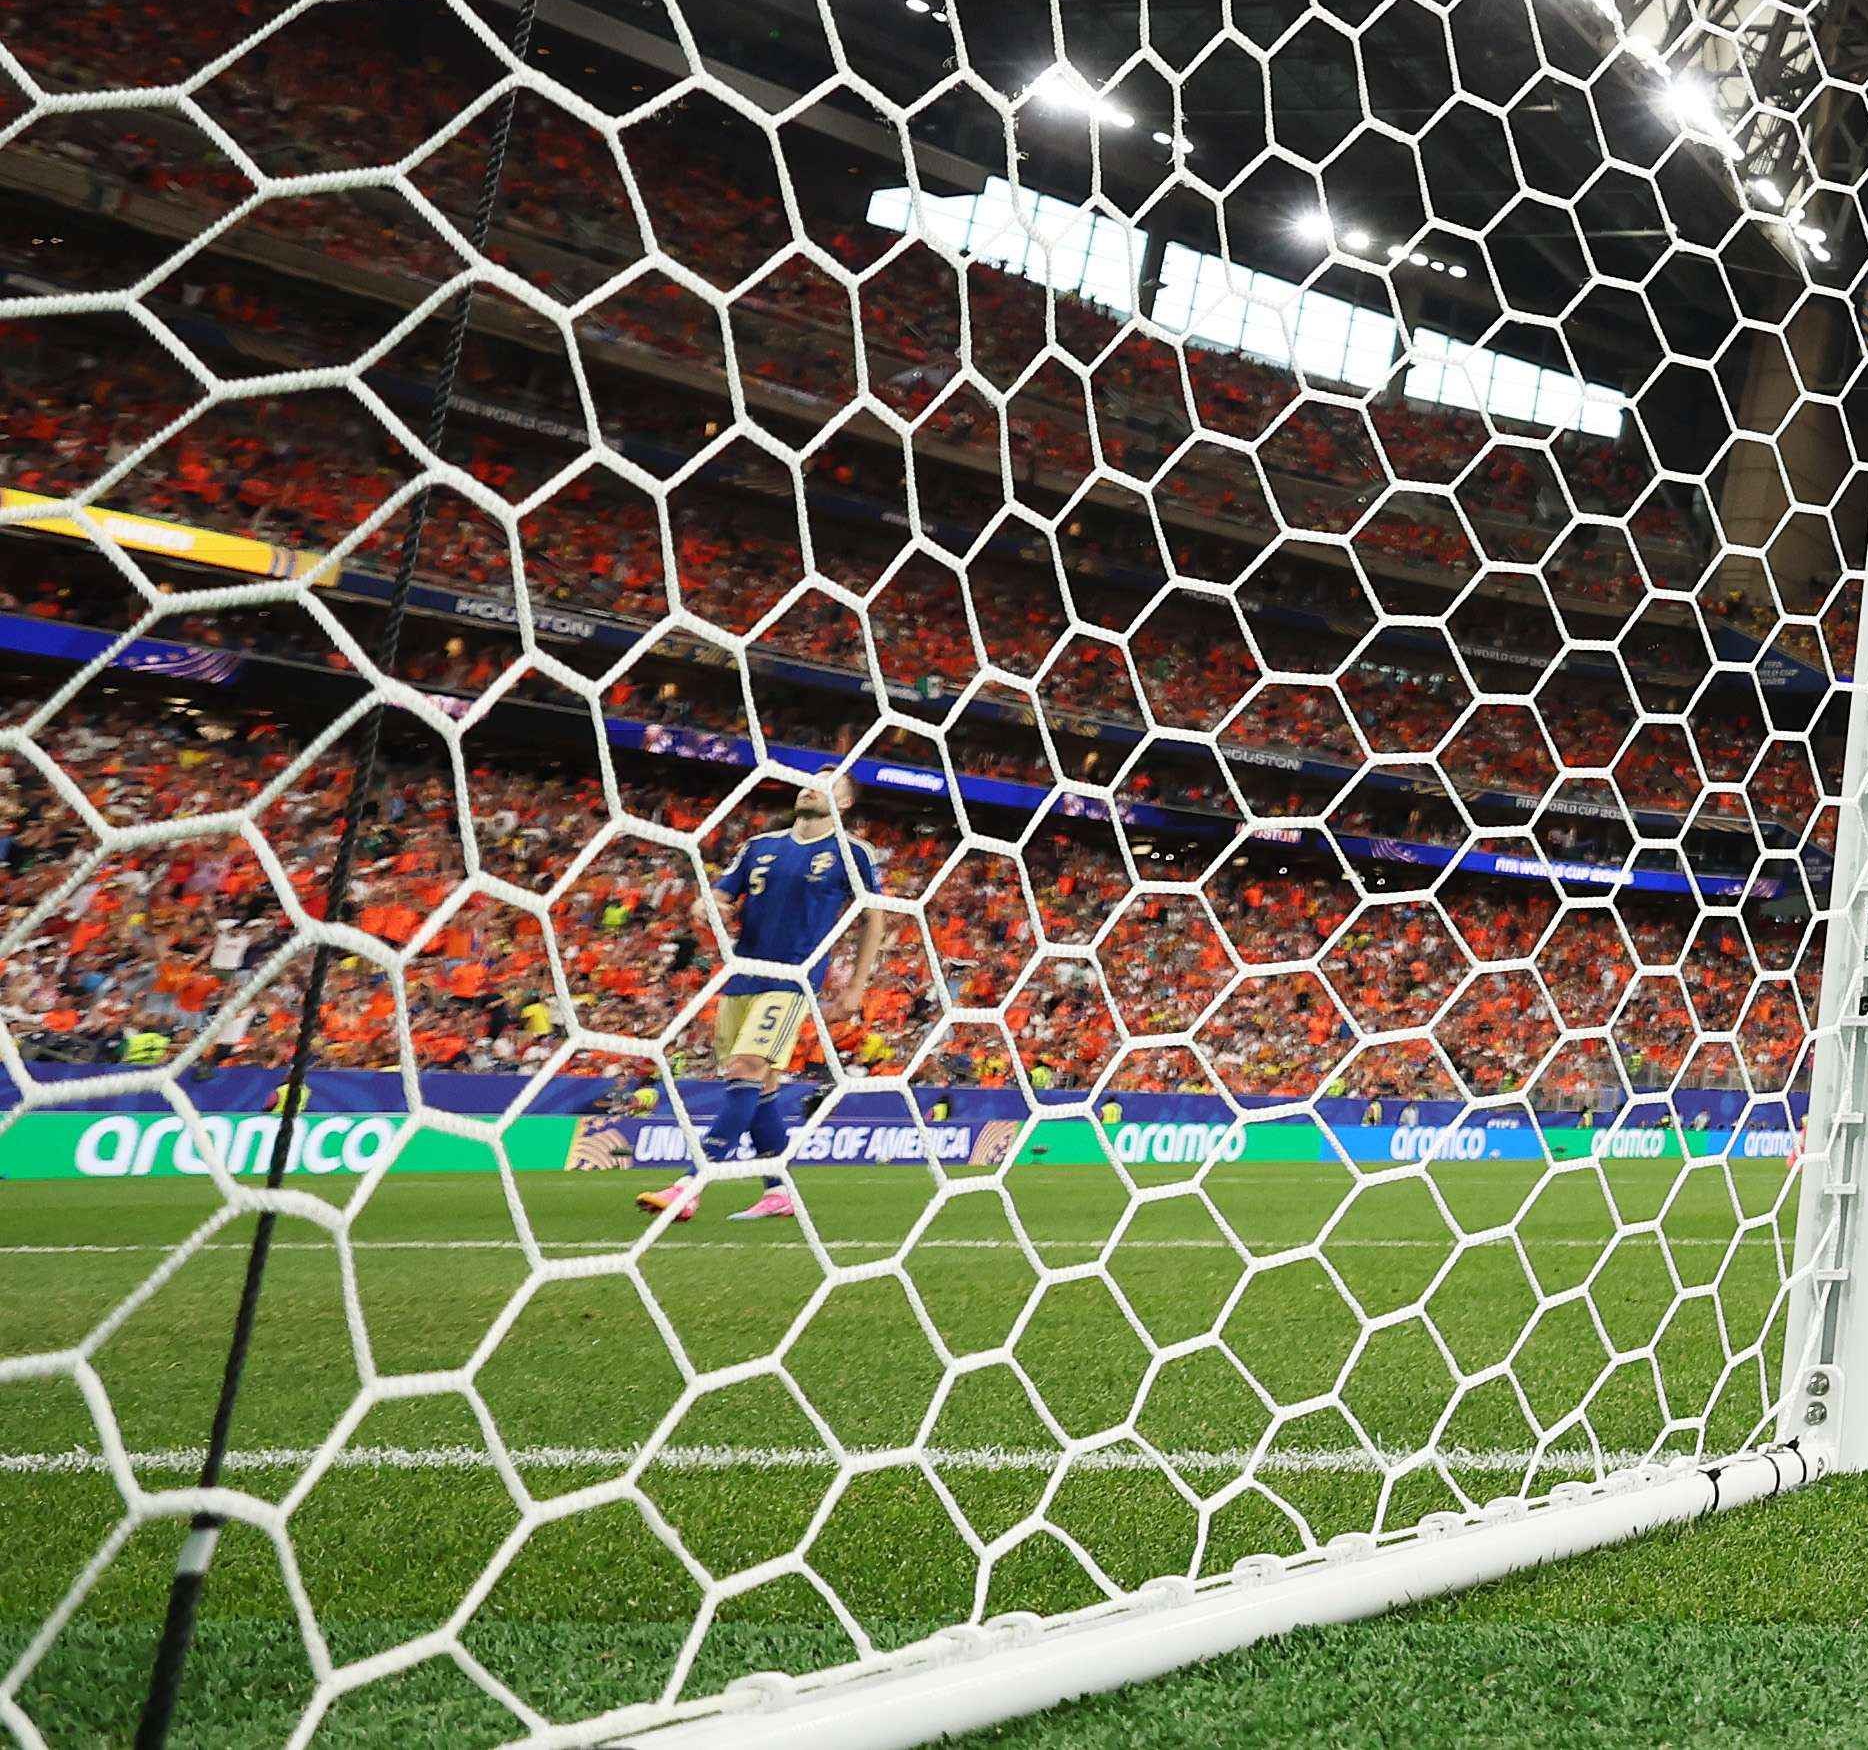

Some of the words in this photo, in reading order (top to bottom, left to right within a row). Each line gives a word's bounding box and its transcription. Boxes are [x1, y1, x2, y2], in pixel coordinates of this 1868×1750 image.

[455, 599, 596, 639] HOUTON
[1577, 806, 1599, 817] CUP
[748, 865, 771, 896] 5
[1495, 857, 1520, 872] FIFA
[1564, 865, 1590, 880] CUP
[758, 1005, 782, 1031] 5
[74, 1114, 397, 1176] aramco
[832, 1126, 871, 1161] OF
[863, 1126, 974, 1160] AMERICA
[1114, 1123, 1247, 1163] aramco
[1390, 1125, 1487, 1161] aramco
